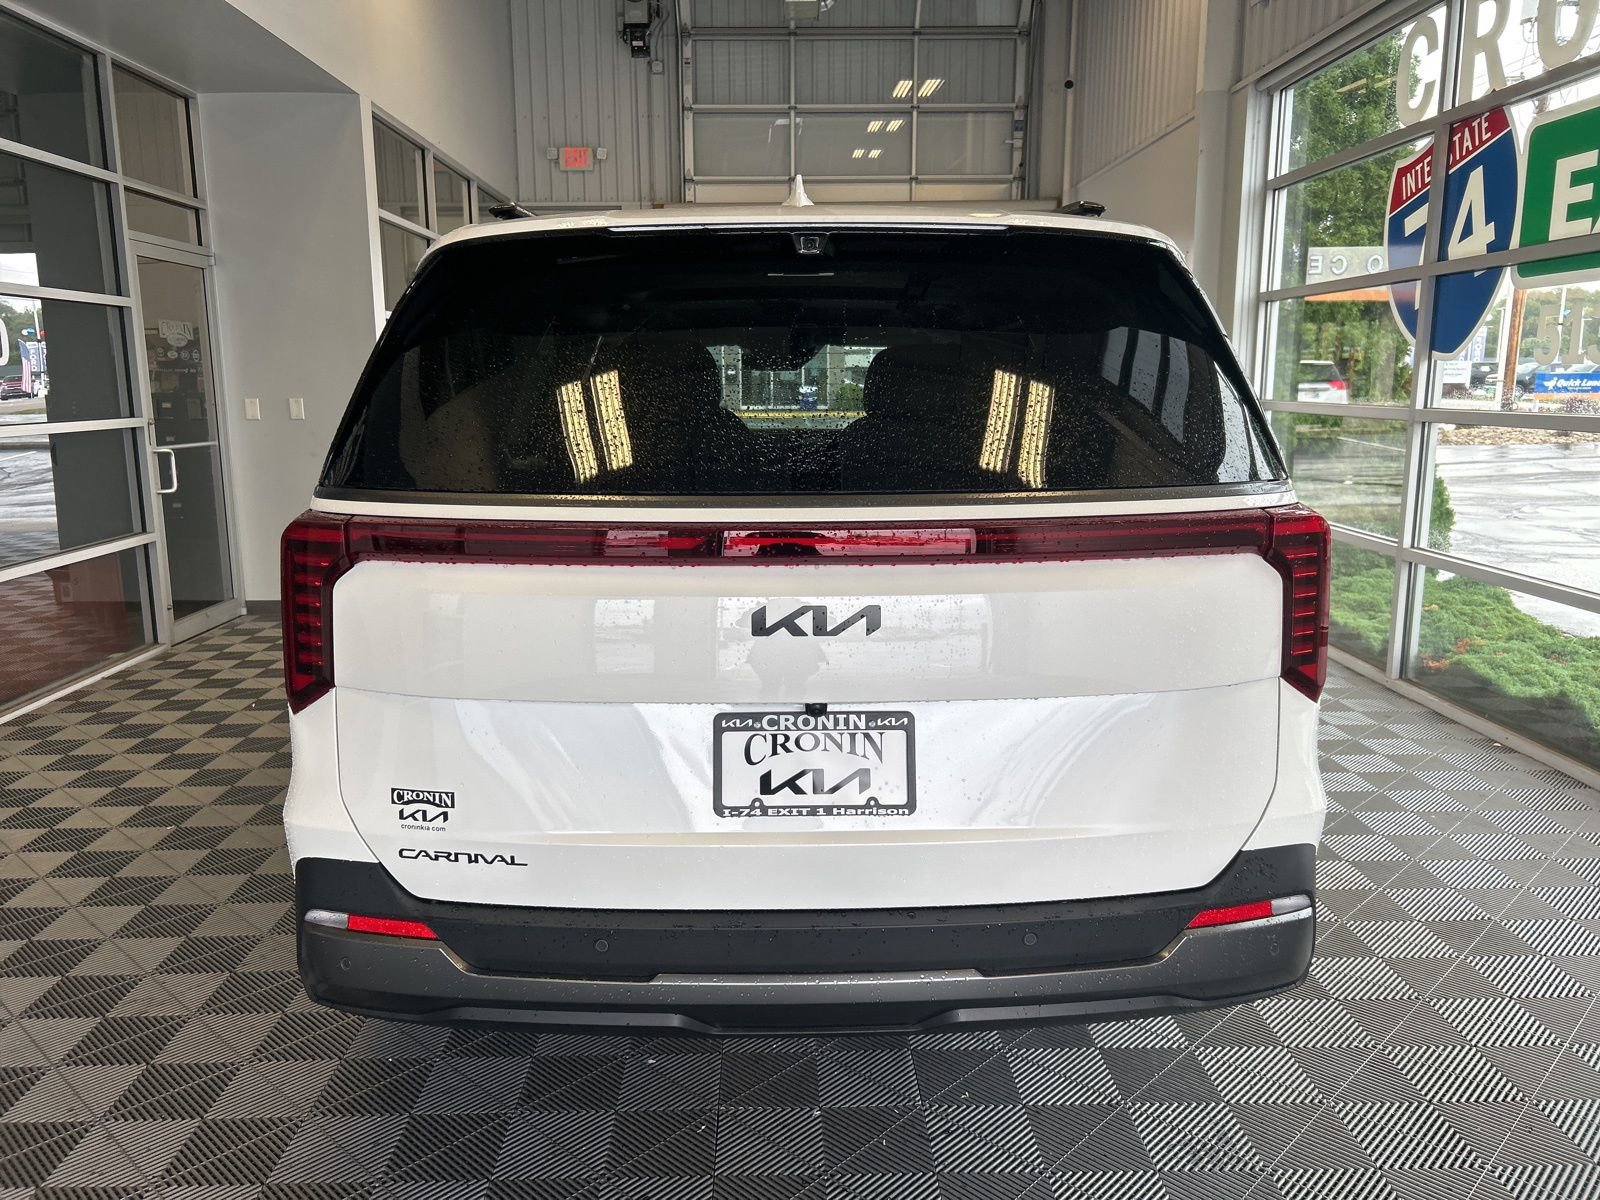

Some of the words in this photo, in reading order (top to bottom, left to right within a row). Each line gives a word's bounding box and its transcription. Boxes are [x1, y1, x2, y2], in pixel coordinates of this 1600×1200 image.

[1401, 111, 1492, 201] INTETATE
[1549, 149, 1600, 242] E
[751, 605, 881, 637] KIA
[721, 718, 753, 728] KIA
[761, 714, 866, 731] CRONIN
[877, 717, 908, 726] KIA
[744, 732, 885, 766] CRONIN
[759, 768, 871, 796] KIA
[393, 789, 452, 808] CRONIN
[398, 808, 449, 823] KIA
[722, 809, 762, 818] I-74
[767, 807, 811, 817] EXIT
[816, 807, 827, 817] 1
[832, 807, 909, 816] Harrison
[398, 848, 529, 867] CARNIVAL
